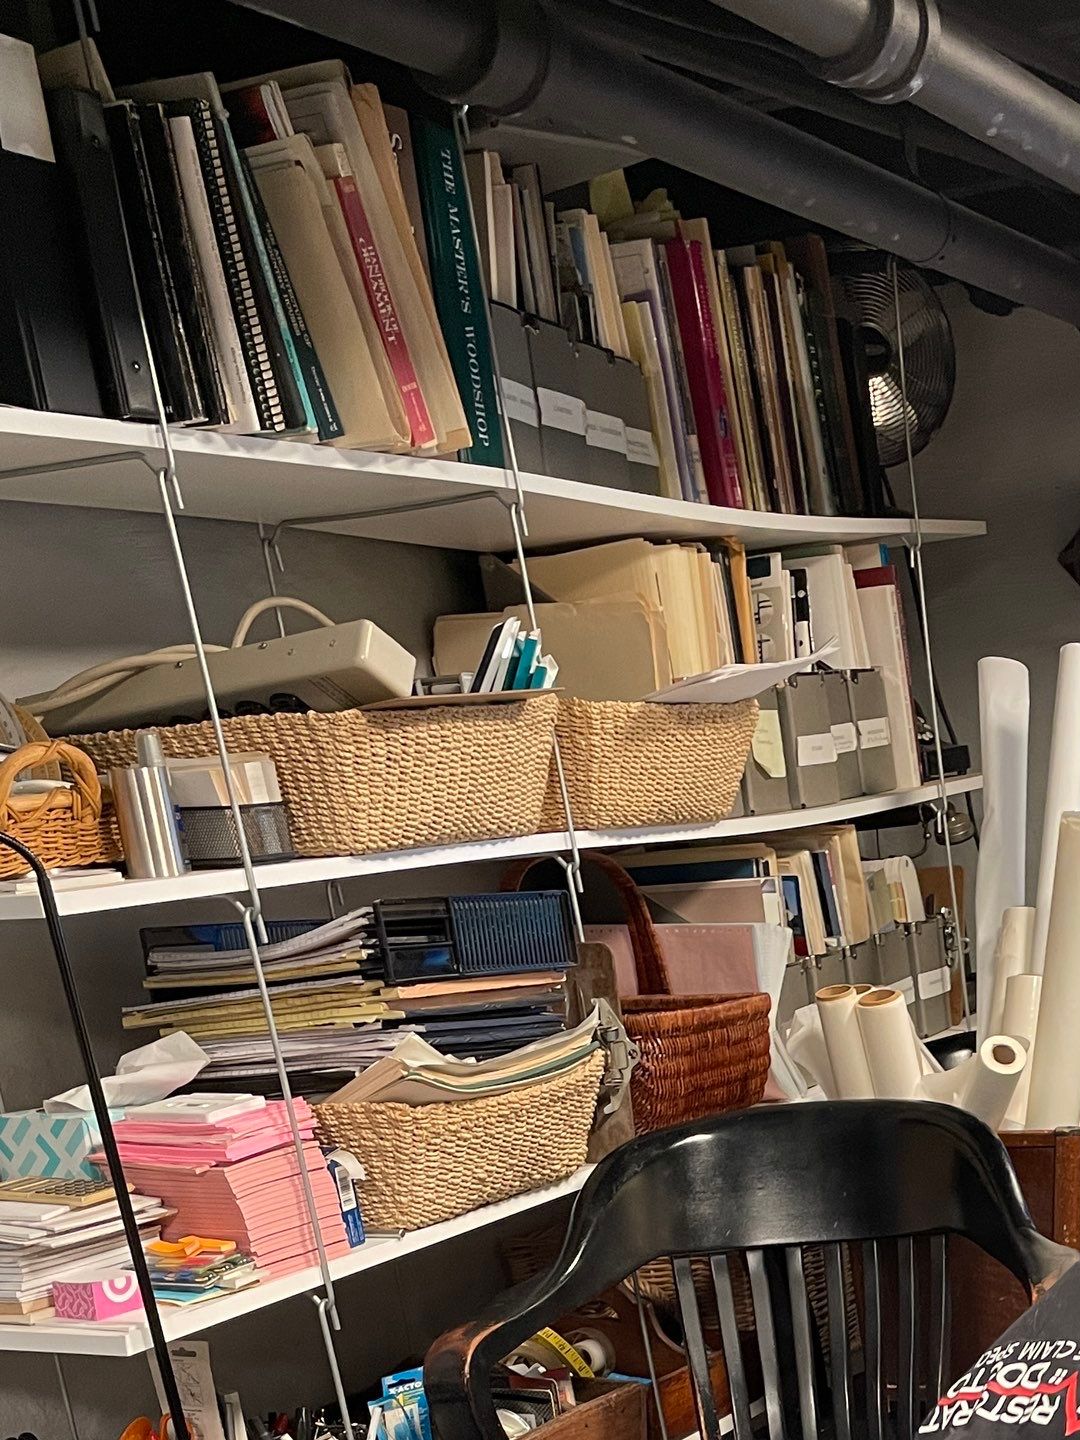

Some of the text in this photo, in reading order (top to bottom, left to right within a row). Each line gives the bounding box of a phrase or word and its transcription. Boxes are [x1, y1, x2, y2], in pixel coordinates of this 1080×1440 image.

[358, 237, 398, 343] ORNAMENT
[366, 246, 395, 316] HANDBOOK
[440, 150, 489, 447] THE MASTER'S WOODSHOP
[1019, 1340, 1077, 1361] CLAIM
[389, 1381, 423, 1395] X-ACTO
